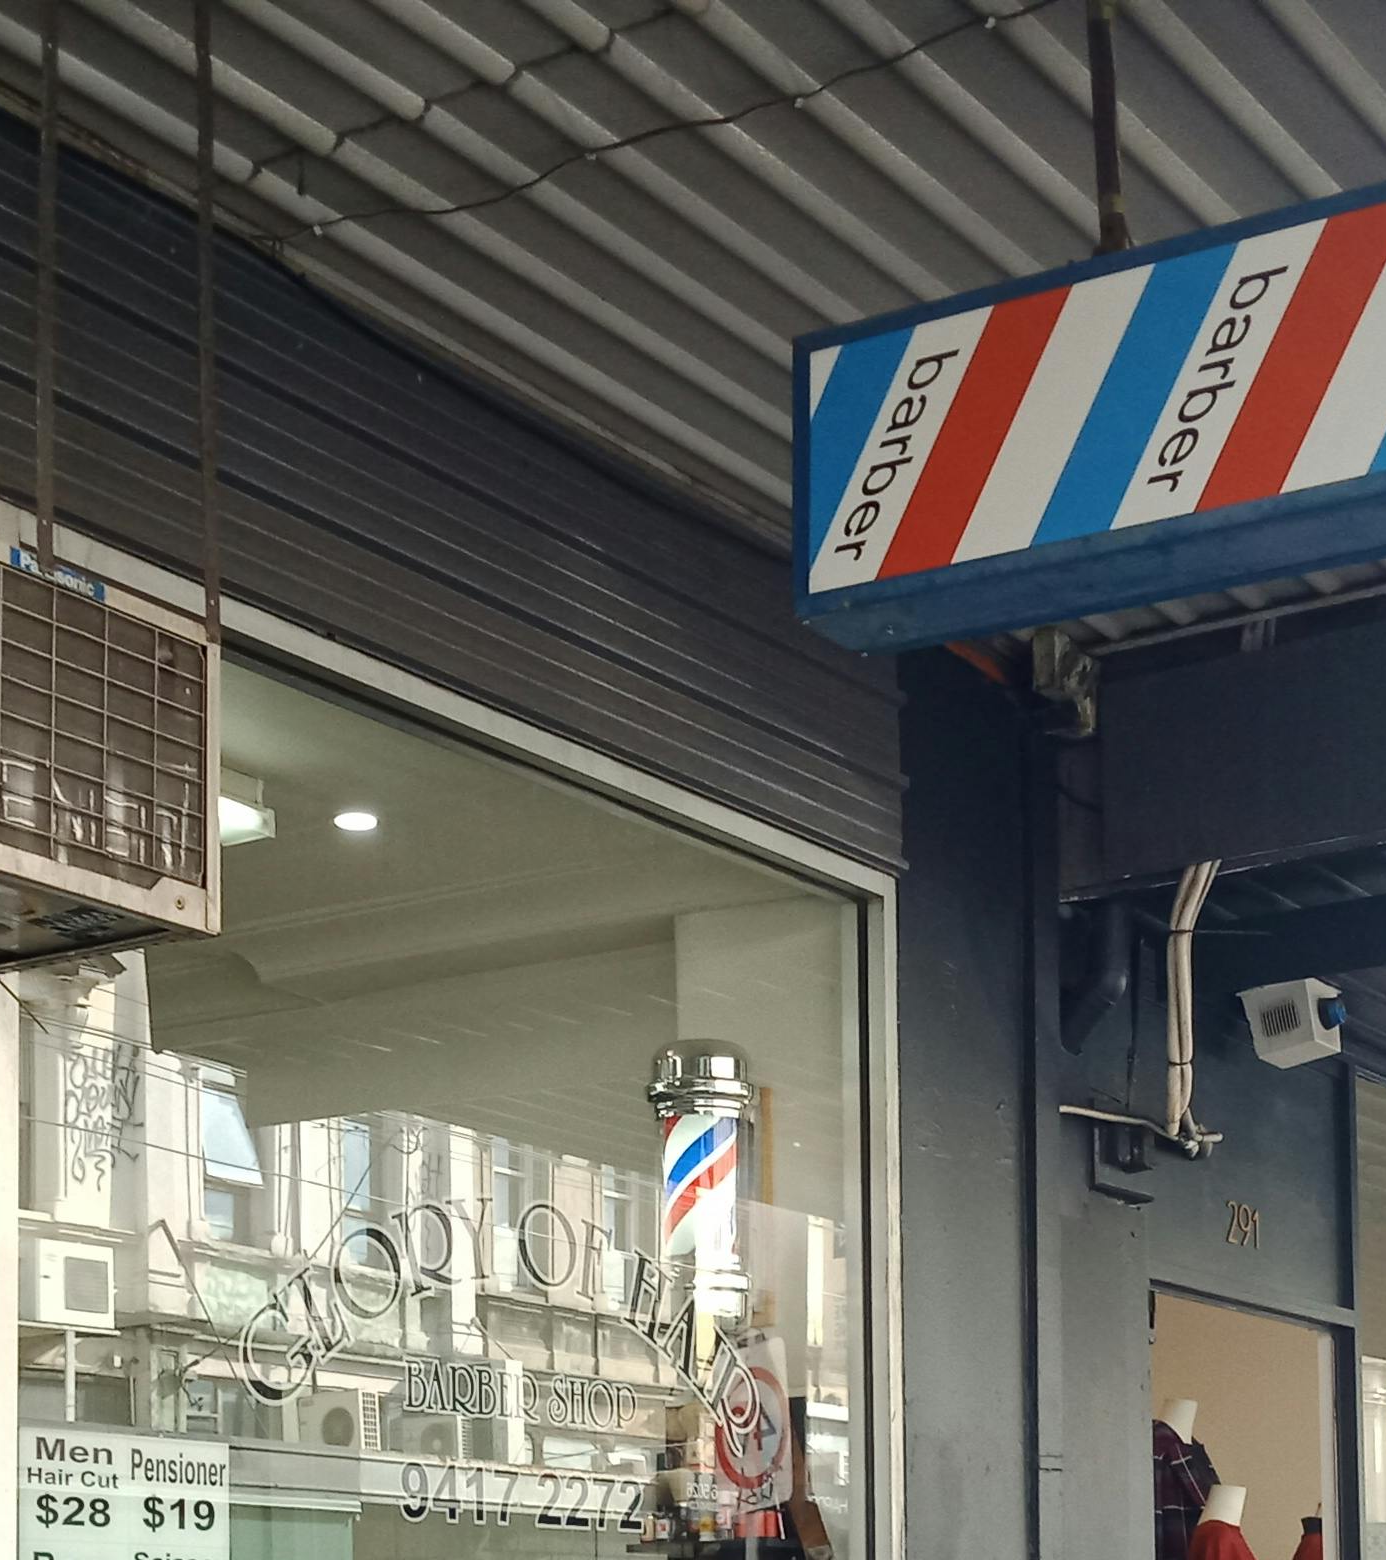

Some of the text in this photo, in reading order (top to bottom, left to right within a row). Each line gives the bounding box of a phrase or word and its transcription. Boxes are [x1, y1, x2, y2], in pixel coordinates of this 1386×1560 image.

[1147, 265, 1289, 492] barber
[833, 350, 959, 561] barber
[19, 552, 96, 598] Pasonic
[1225, 1200, 1261, 1250] 291
[239, 1197, 494, 1407] GLORY
[517, 1202, 613, 1306] OF
[403, 1354, 637, 1430] BARBER SHOP
[36, 1437, 113, 1465] Men
[131, 1448, 226, 1487] Pensioner
[27, 1467, 119, 1489] Hair Cut
[401, 1462, 646, 1534] 9417 2272
[36, 1494, 111, 1528] $28
[143, 1497, 215, 1532] $19
